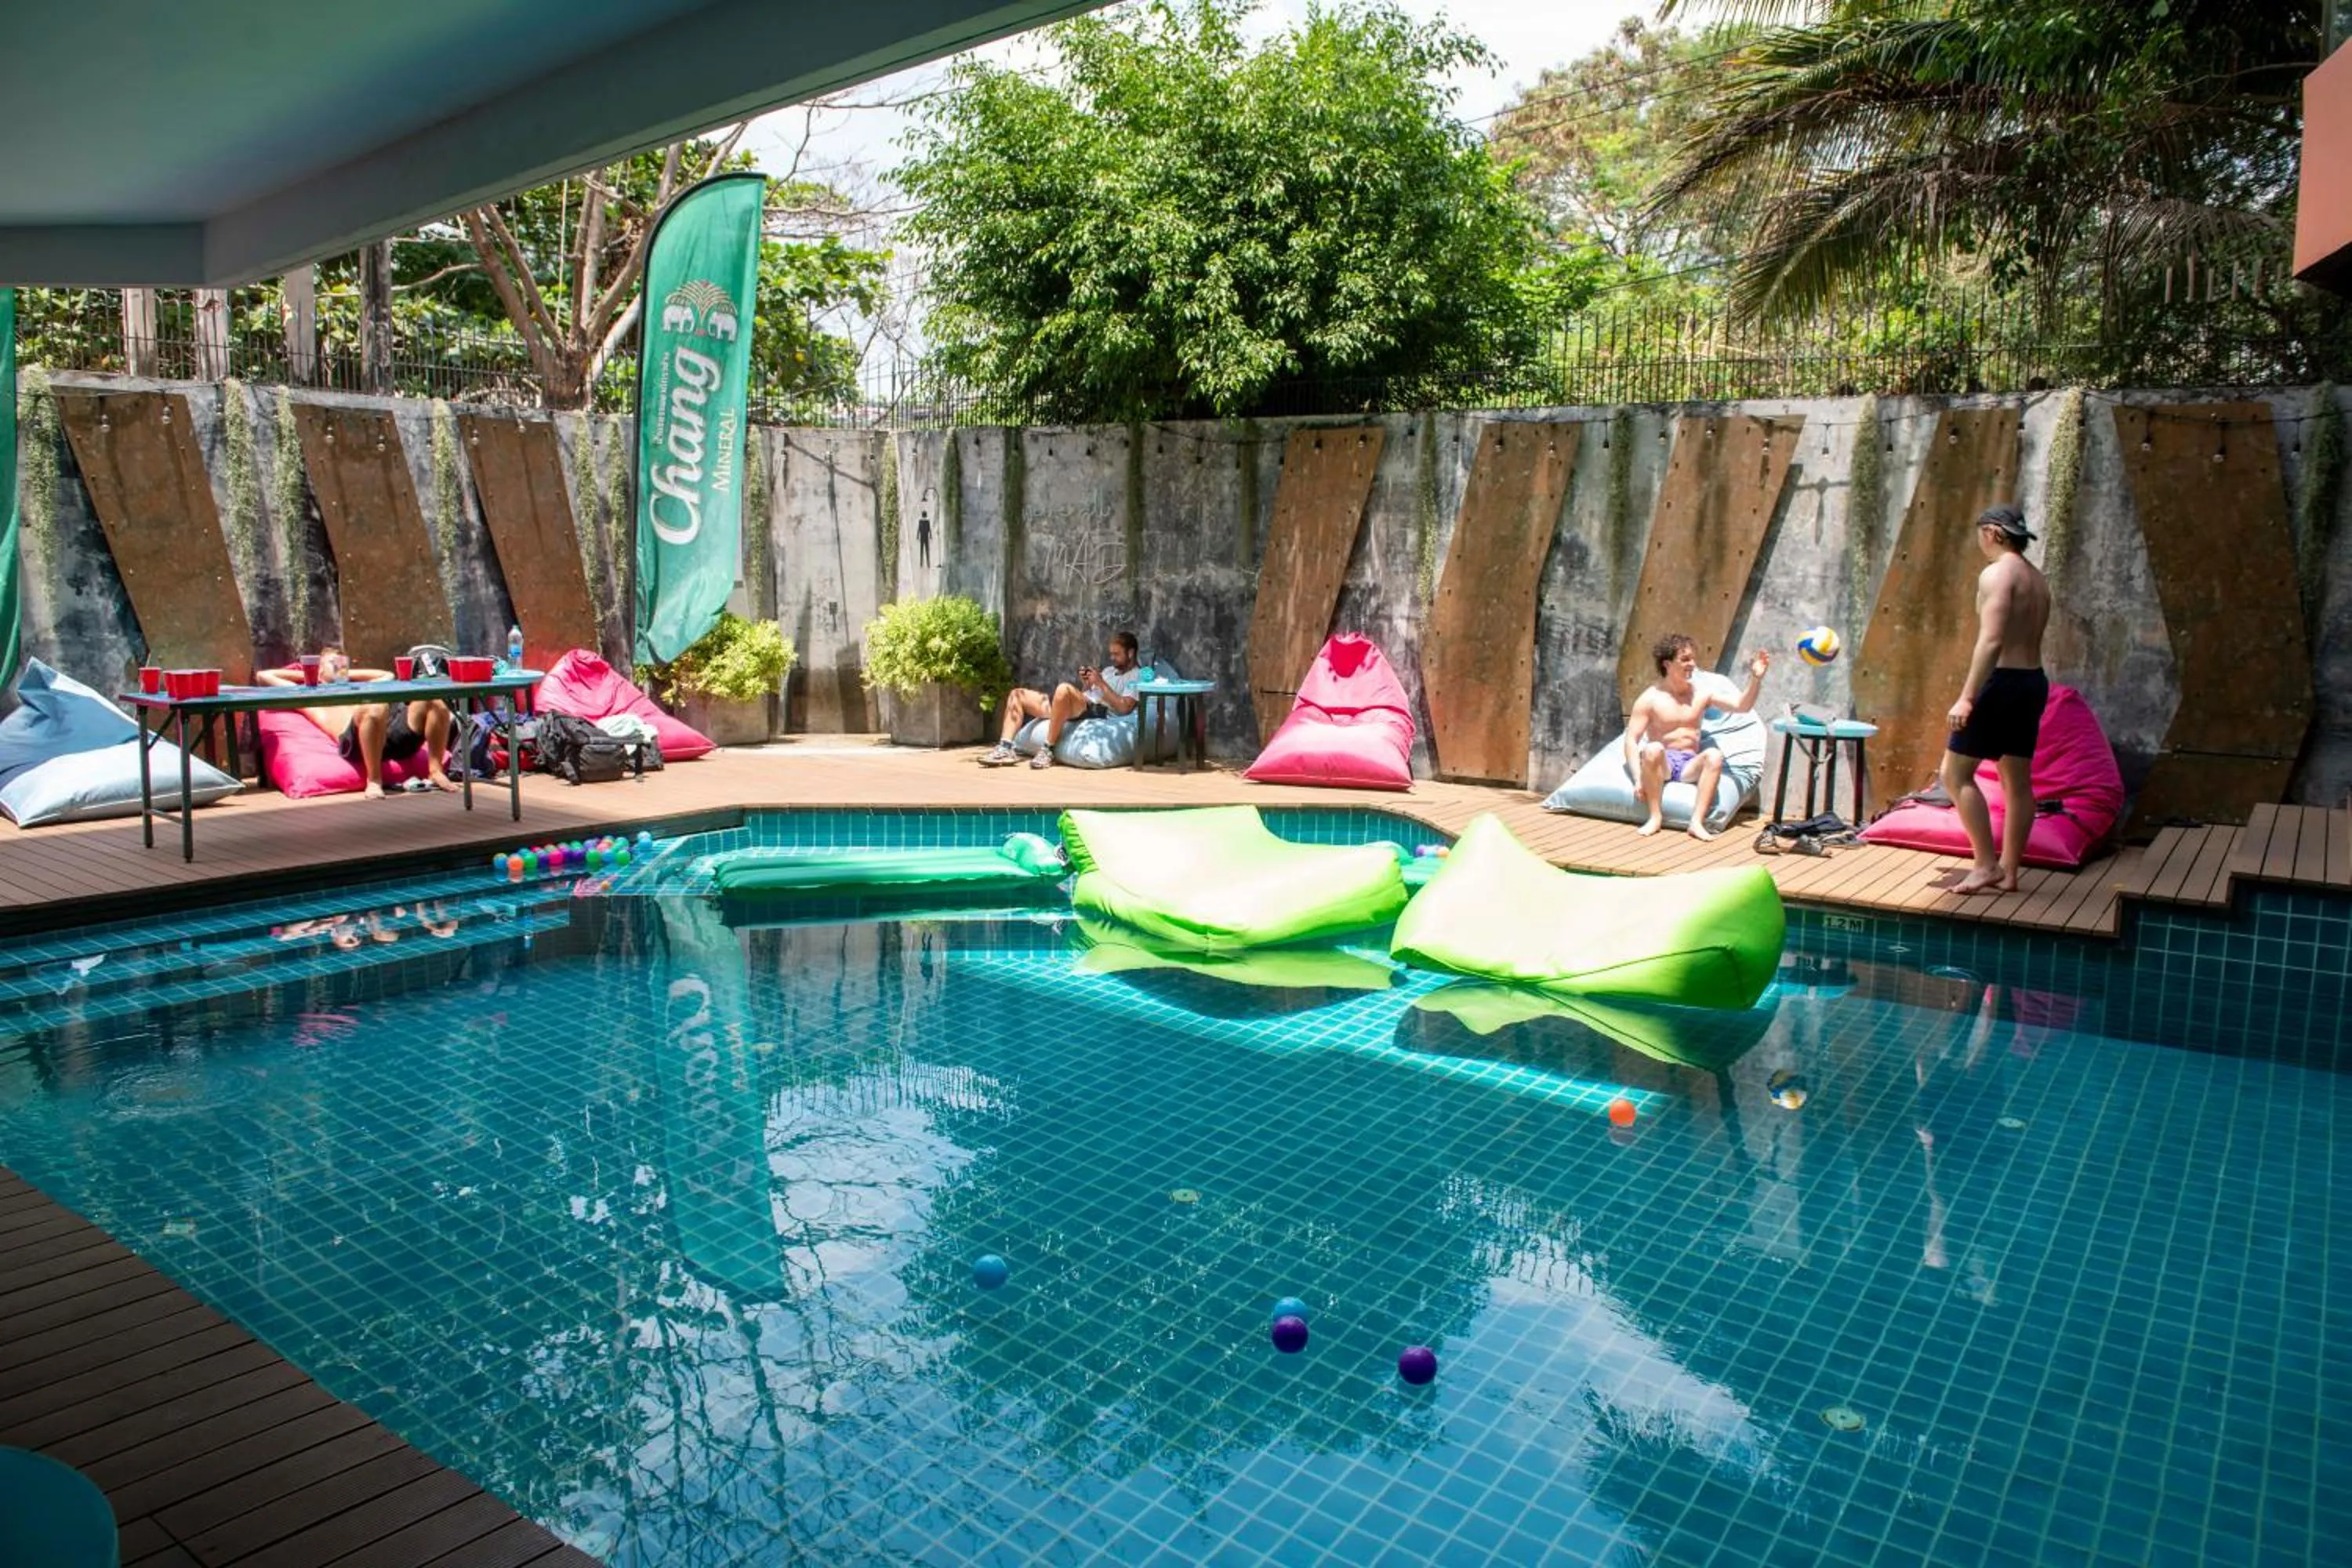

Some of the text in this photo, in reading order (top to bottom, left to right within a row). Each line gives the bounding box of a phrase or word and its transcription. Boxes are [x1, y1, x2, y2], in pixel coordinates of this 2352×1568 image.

[650, 347, 720, 544] Chang
[712, 408, 737, 492] MINERAL
[1850, 919, 1863, 931] M
